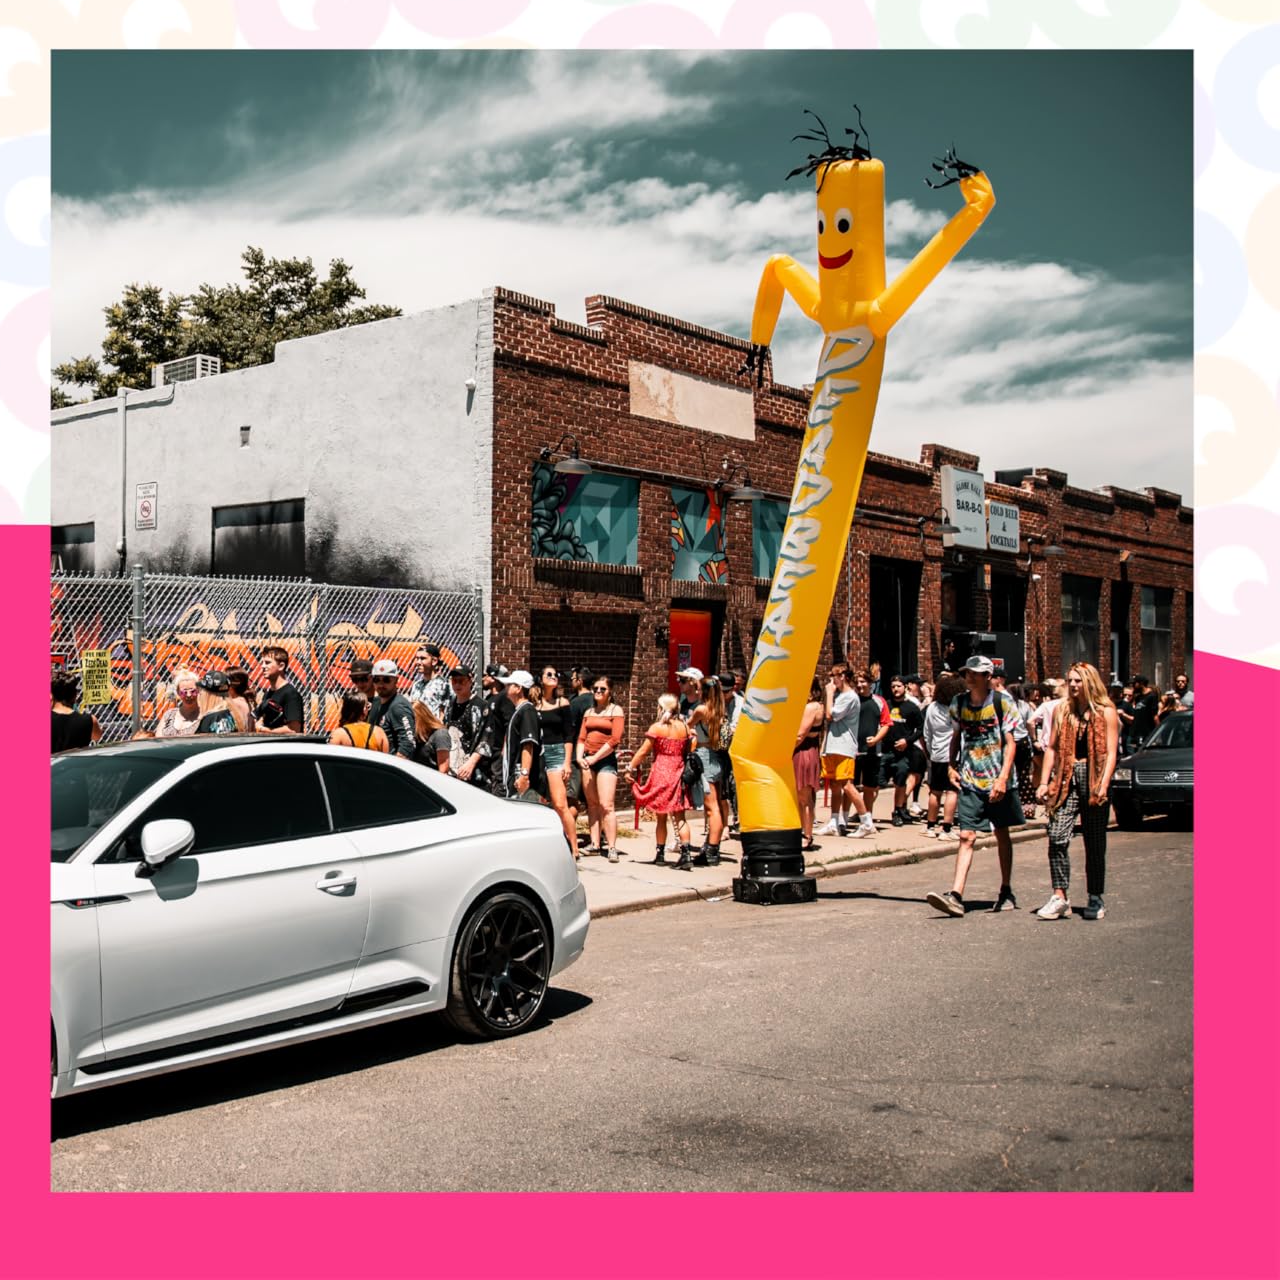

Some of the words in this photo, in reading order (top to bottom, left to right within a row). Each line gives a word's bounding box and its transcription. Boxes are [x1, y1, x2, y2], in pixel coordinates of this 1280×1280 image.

[956, 499, 982, 514] BAR-B-Q
[990, 505, 1004, 517] COLD
[990, 534, 1018, 549] COCKTAILS
